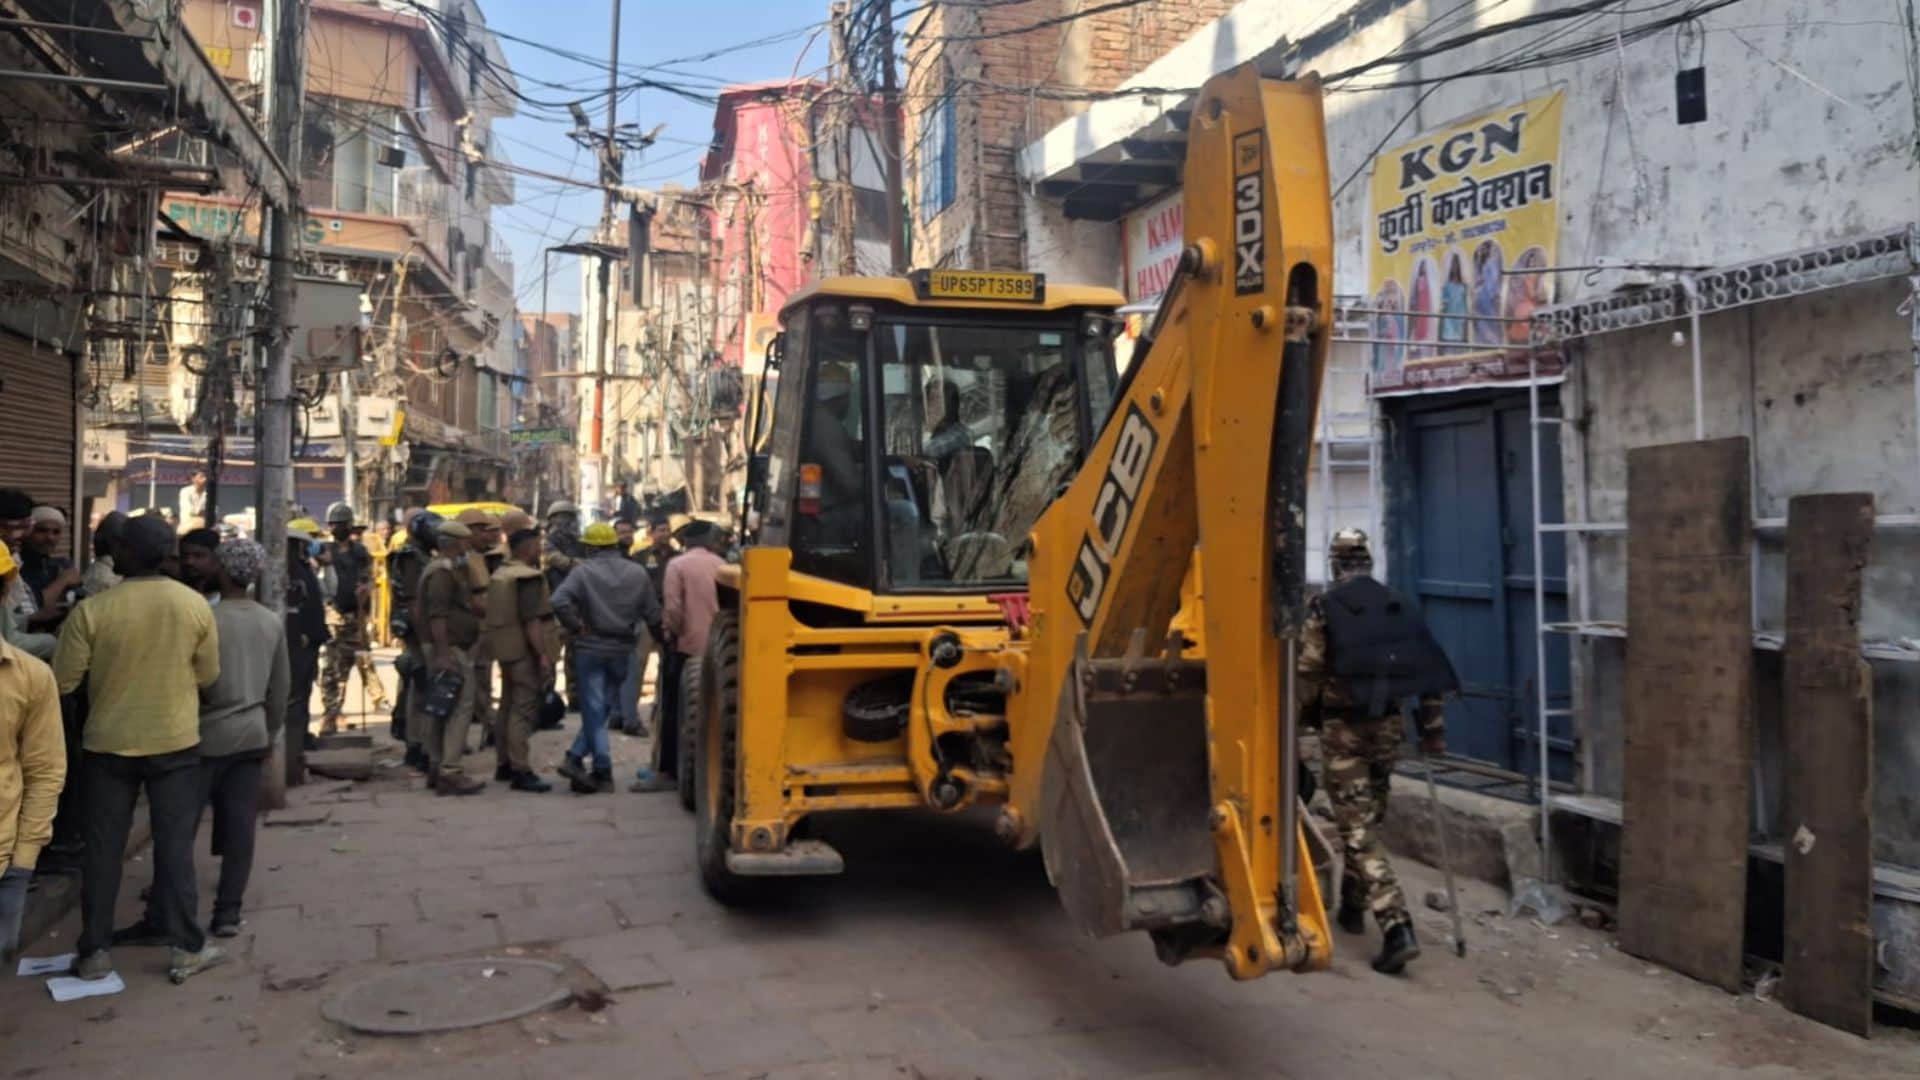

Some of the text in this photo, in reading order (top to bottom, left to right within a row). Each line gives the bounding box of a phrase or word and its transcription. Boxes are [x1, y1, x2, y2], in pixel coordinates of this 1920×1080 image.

[1399, 112, 1528, 190] KGN
[1236, 174, 1262, 277] 3DX
[1377, 189, 1425, 253] कुर्ती
[1431, 163, 1553, 226] कलेक्शन
[940, 275, 1033, 296] UP65PT3589
[1078, 412, 1152, 620] JCB
